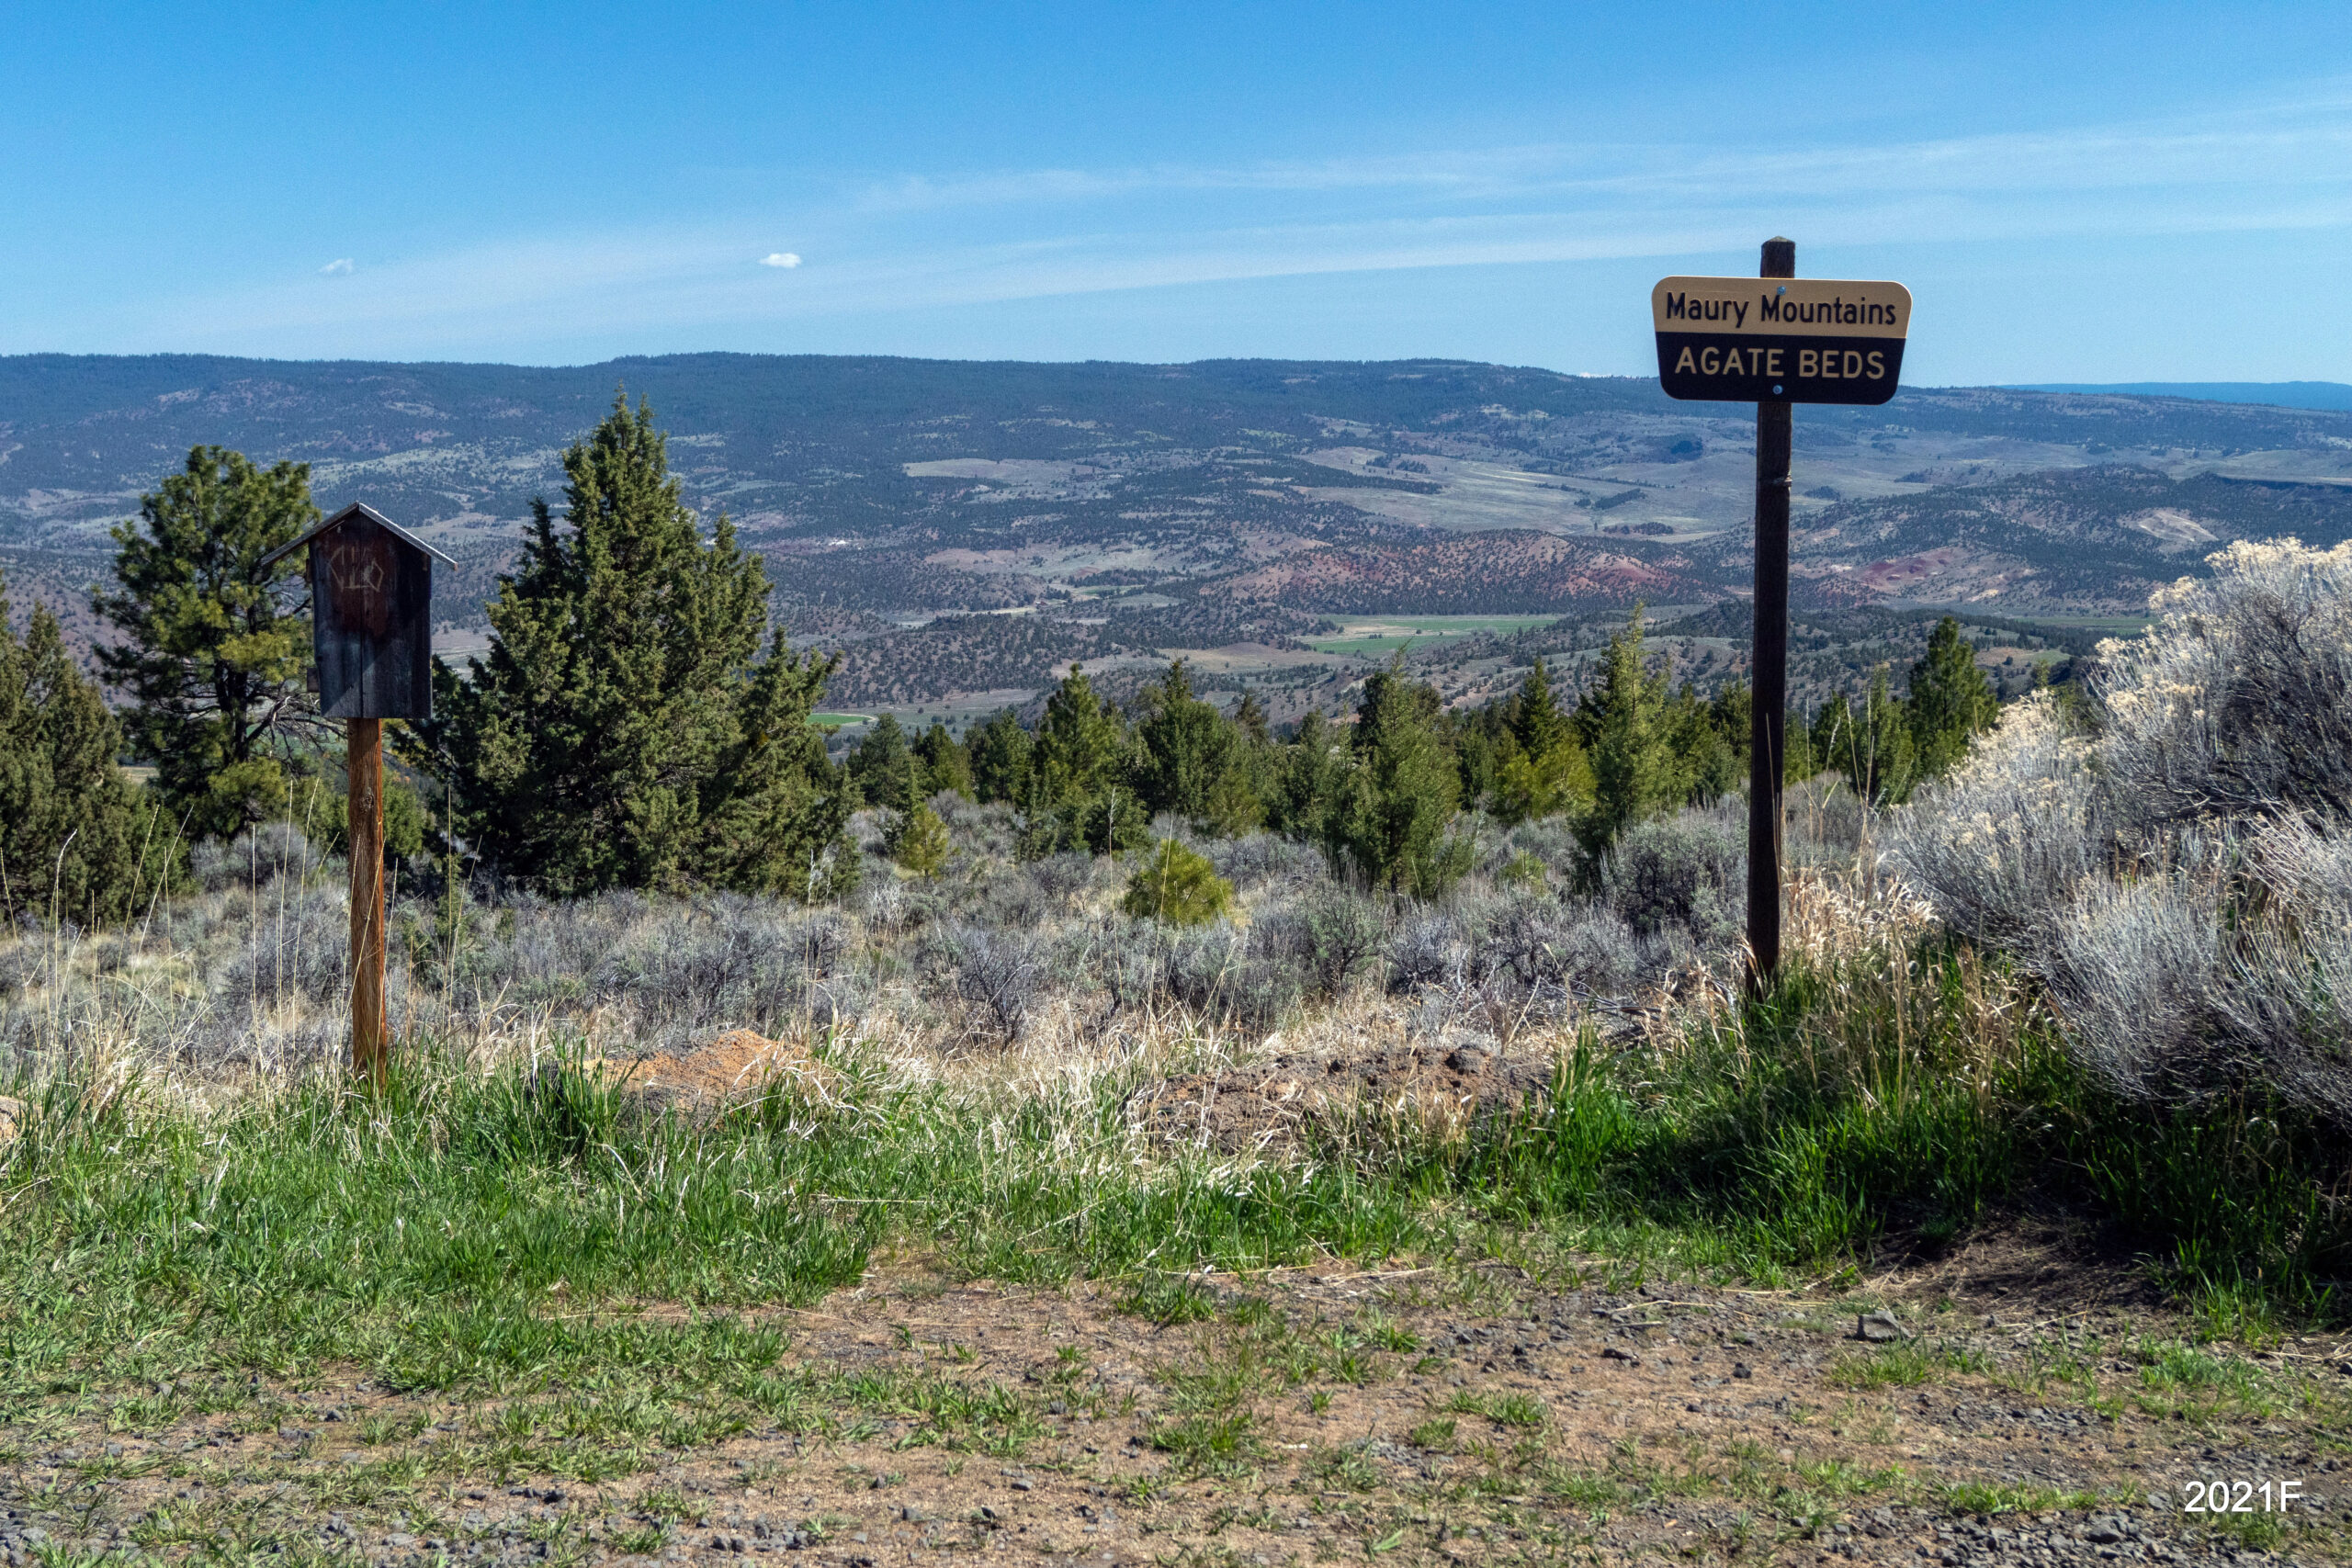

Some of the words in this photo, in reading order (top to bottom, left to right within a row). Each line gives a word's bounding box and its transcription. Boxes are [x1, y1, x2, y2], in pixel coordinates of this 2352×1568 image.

[1667, 292, 1748, 328] Maury
[1761, 295, 1896, 325] Mountains
[1675, 346, 1784, 377] AGATE
[1799, 349, 1884, 379] BEDS
